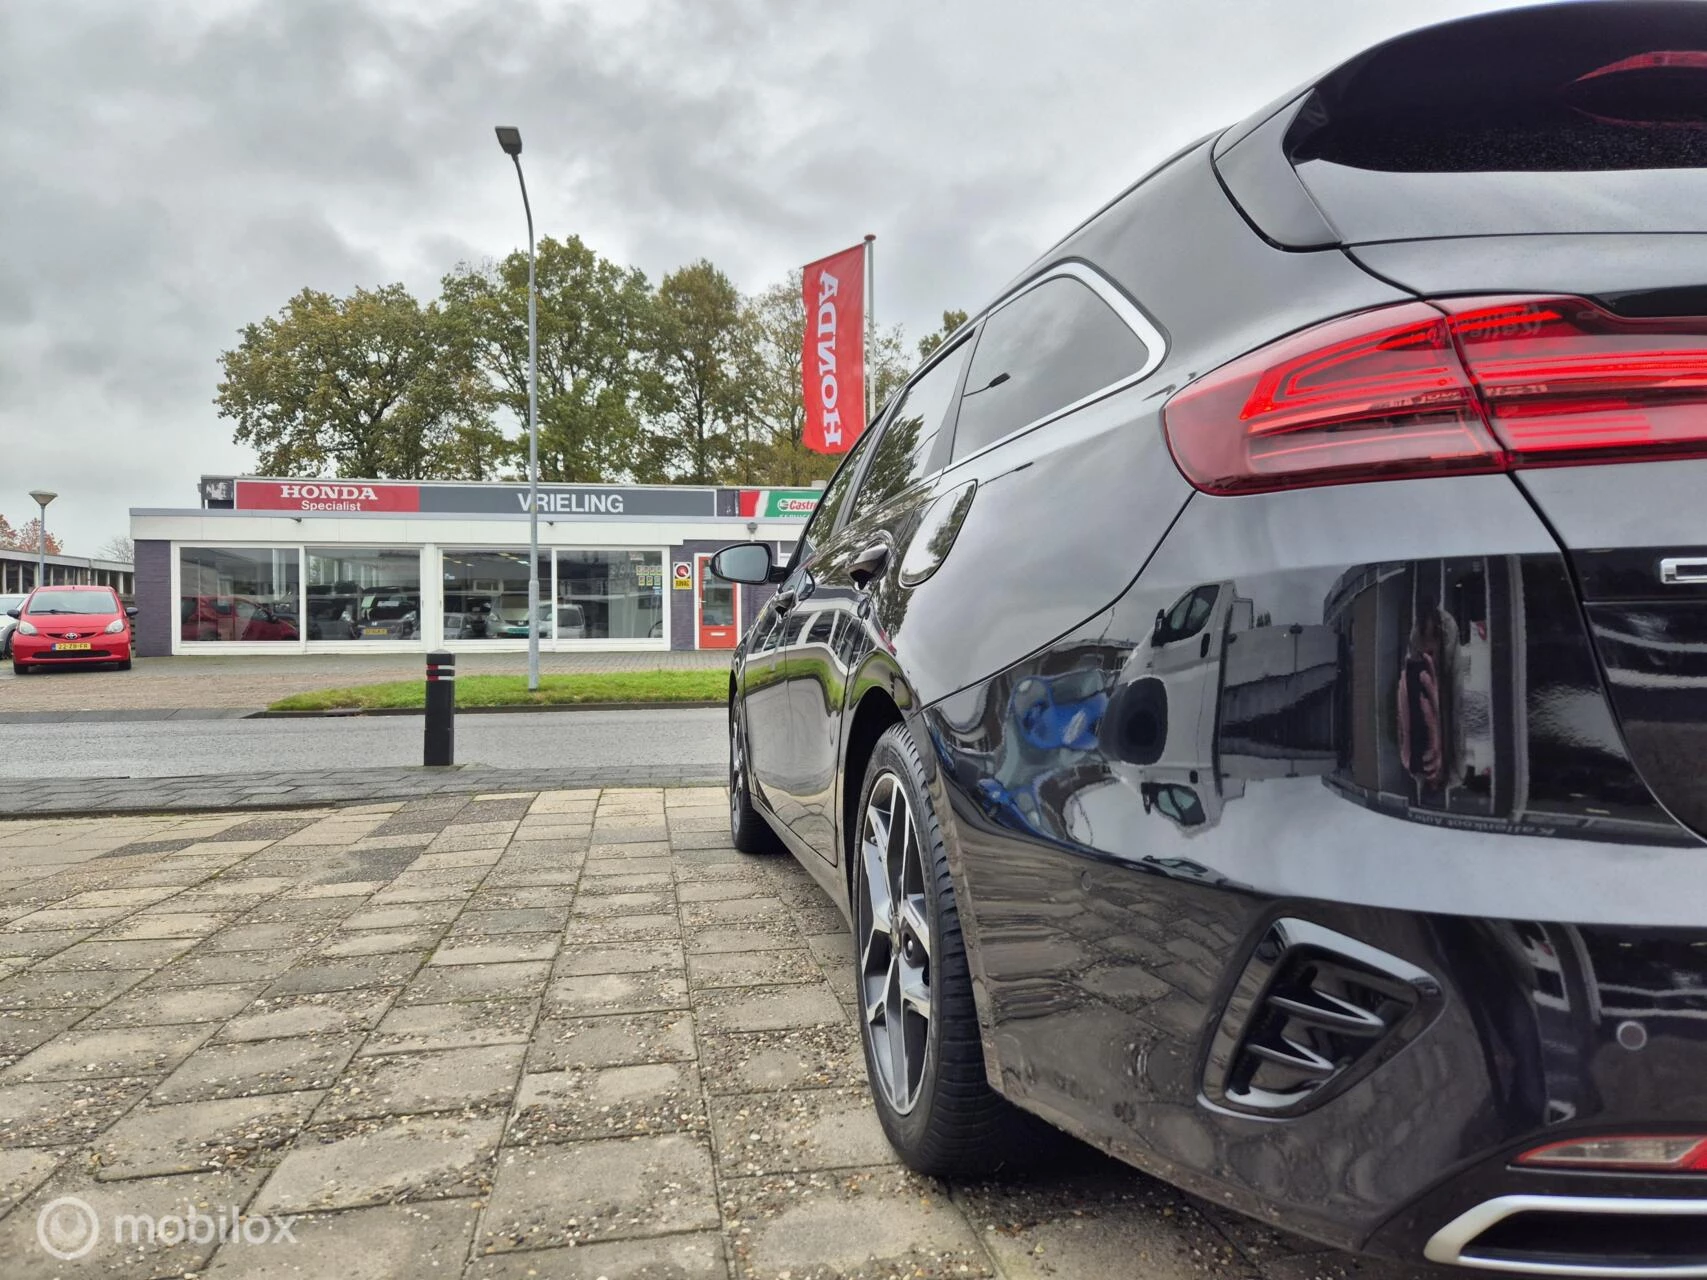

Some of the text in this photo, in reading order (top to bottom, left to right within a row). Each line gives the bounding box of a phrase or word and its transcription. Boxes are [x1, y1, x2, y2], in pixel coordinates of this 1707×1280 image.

[280, 485, 378, 500] HONDA
[301, 500, 361, 511] Specialist
[517, 493, 624, 513] VRIELING
